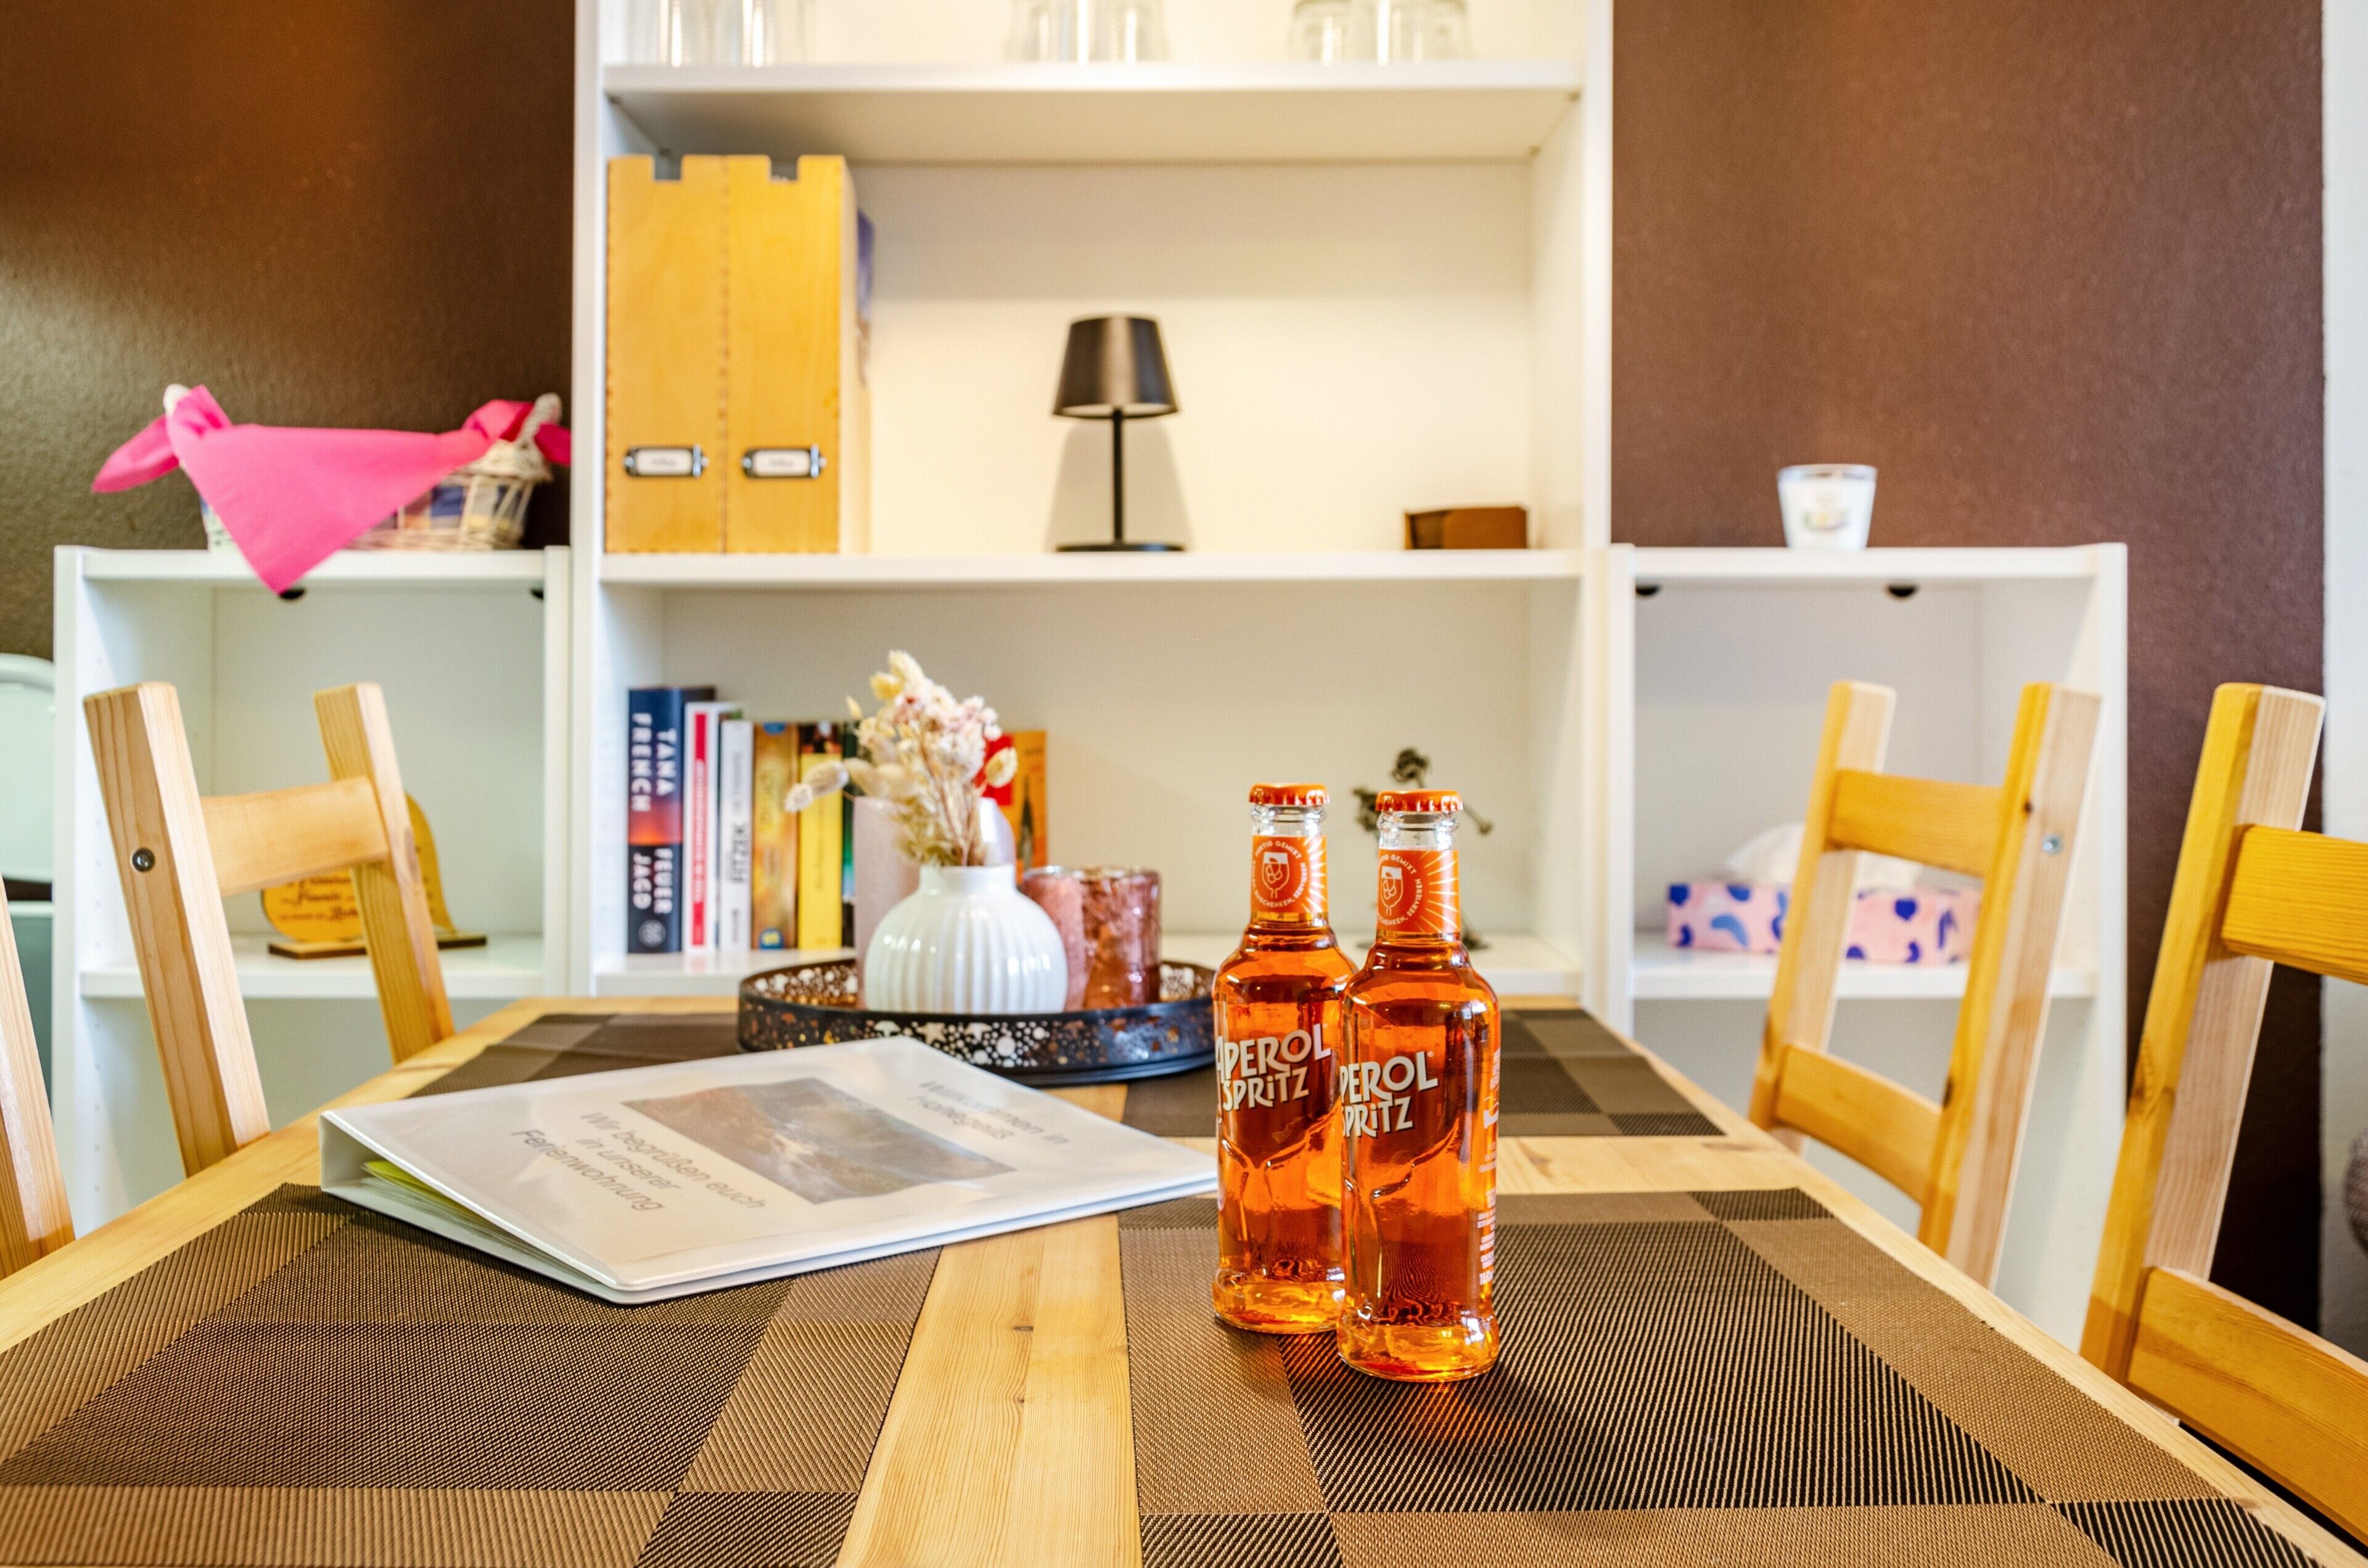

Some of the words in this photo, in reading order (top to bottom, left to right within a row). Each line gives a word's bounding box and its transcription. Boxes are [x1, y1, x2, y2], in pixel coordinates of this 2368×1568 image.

[631, 713, 652, 812] FRENCH
[656, 728, 677, 796] TANA
[1275, 840, 1302, 859] GEMIXT
[1391, 854, 1417, 874] GEMIXT
[633, 852, 652, 909] JAGD
[654, 847, 673, 914] FEUER
[1293, 861, 1307, 898] SERVIEREN
[1407, 878, 1423, 917] SERVIEREN
[1215, 1023, 1331, 1085] APEROL
[1339, 1051, 1439, 1104] PEROL
[511, 1128, 665, 1213] Ferienwohnung
[575, 1137, 604, 1151] in
[596, 1148, 683, 1191] unserer
[579, 1111, 622, 1131] Wir
[611, 1129, 712, 1183] begrüßen
[705, 1180, 767, 1210] euch
